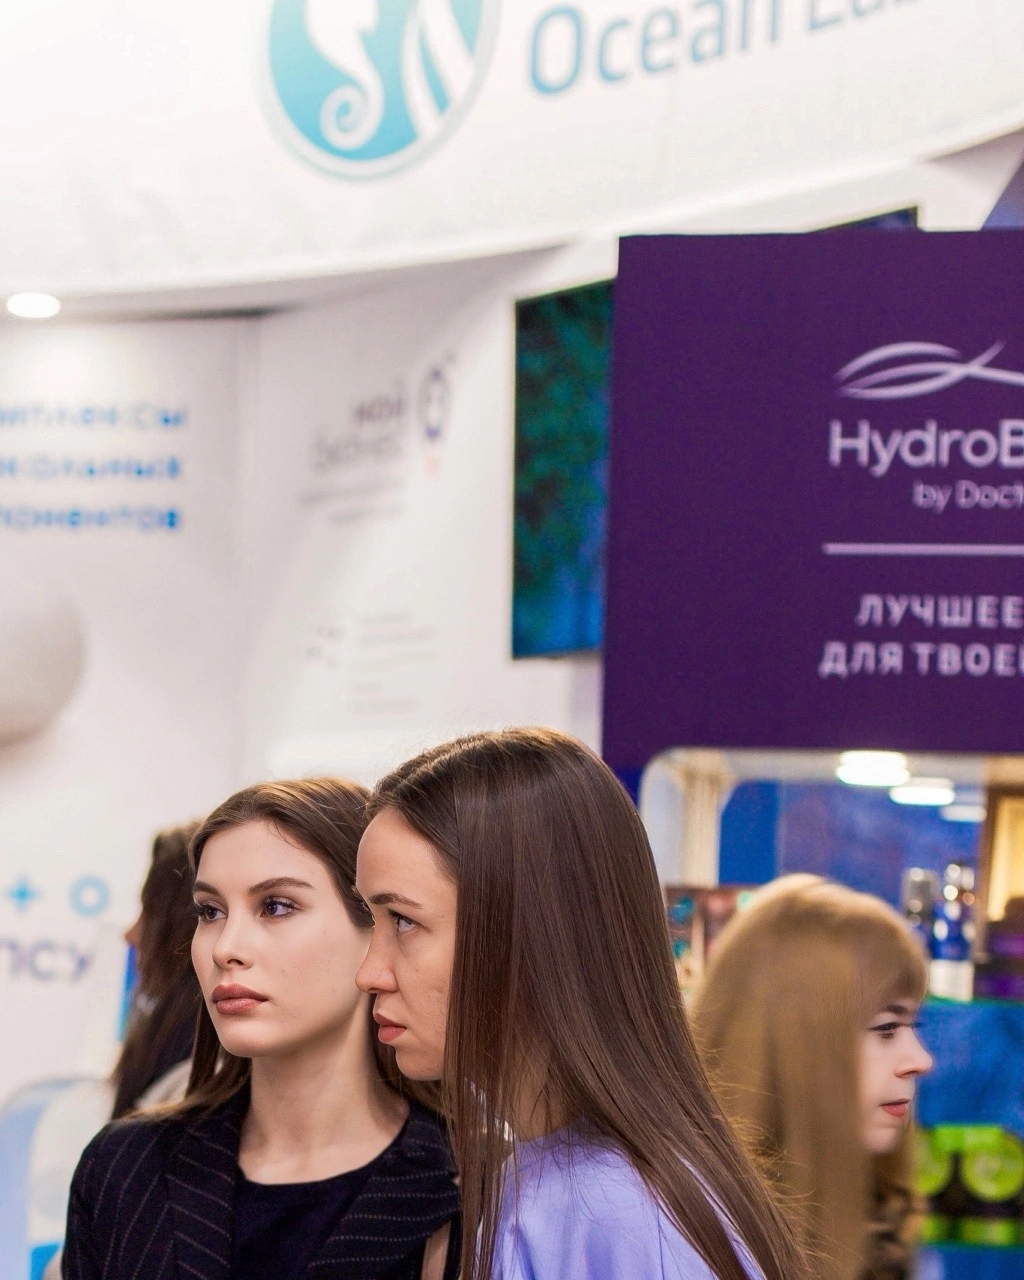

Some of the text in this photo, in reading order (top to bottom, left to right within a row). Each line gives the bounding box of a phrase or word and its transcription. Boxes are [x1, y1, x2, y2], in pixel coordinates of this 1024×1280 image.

[913, 480, 954, 514] by
[855, 594, 1024, 628] ЛУЧШЕЕ
[818, 641, 1024, 679] ДЛЯ ТВОЕ
